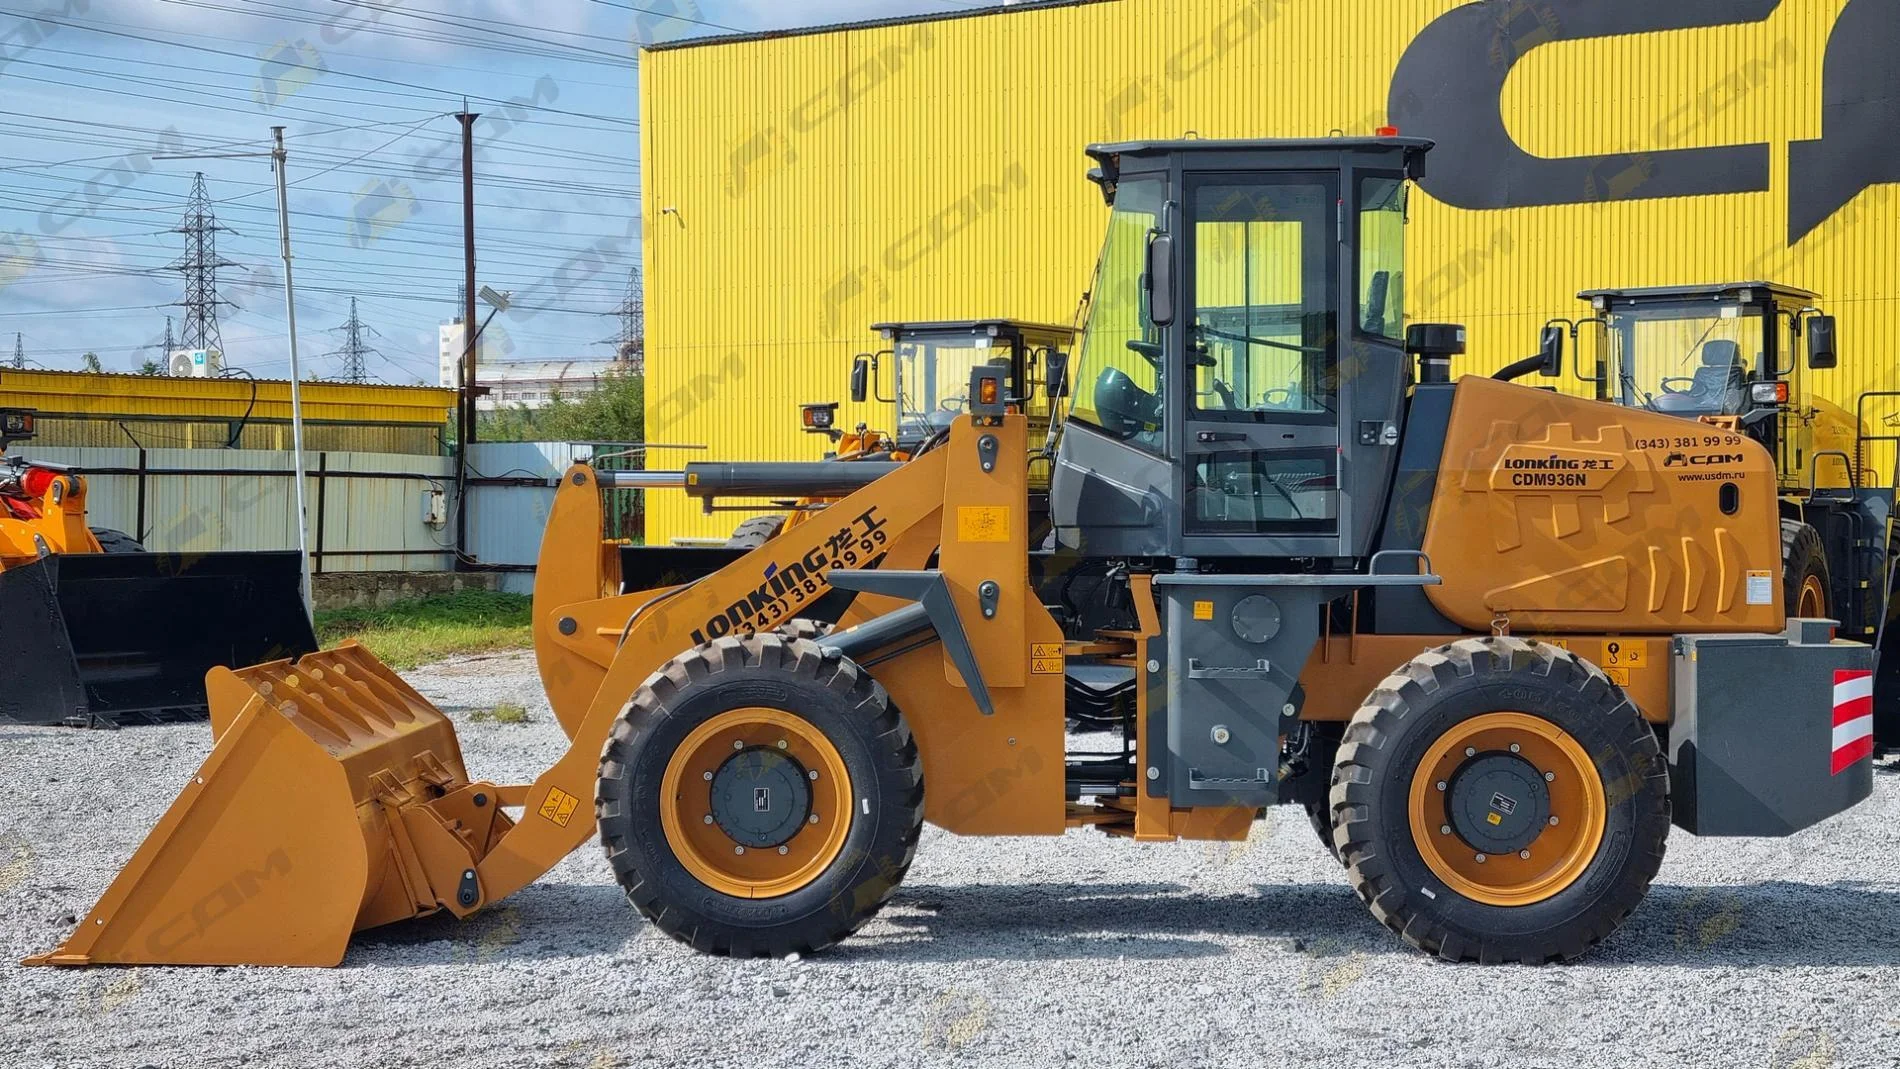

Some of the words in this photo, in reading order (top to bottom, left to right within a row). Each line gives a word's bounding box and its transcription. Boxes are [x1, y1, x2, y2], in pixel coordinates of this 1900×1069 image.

[1635, 438, 1670, 449] (343)
[1674, 437, 1699, 448] 381
[1703, 436, 1720, 446] 99
[1724, 435, 1742, 446] 99
[1512, 473, 1587, 486] CDM936N
[1678, 471, 1745, 482] www.usdm.ru
[790, 571, 828, 603] 381
[830, 550, 858, 570] 99
[860, 530, 887, 554] 99
